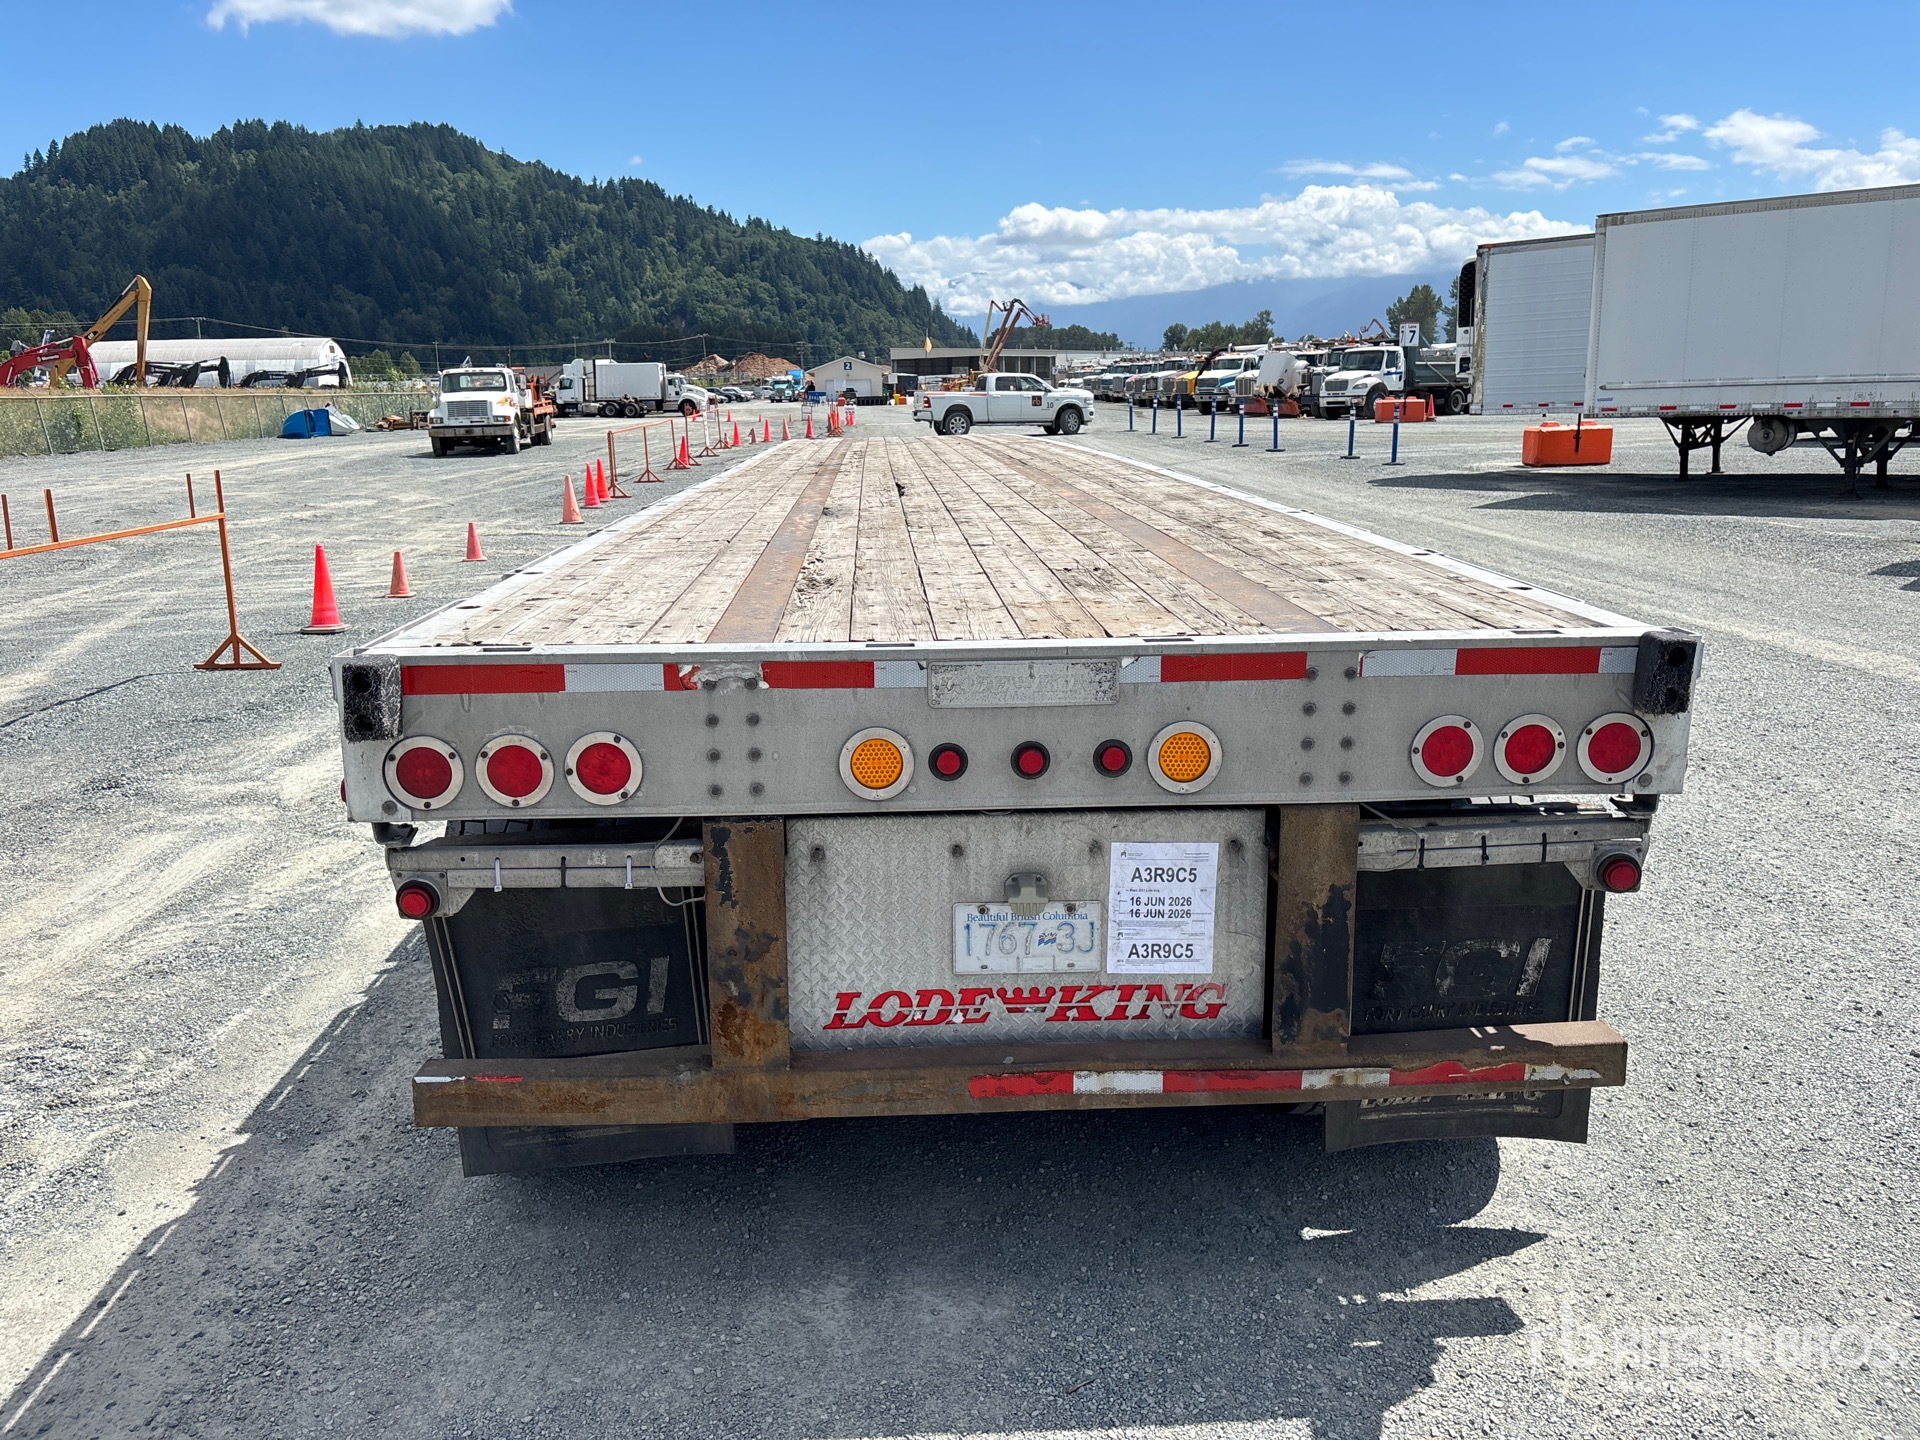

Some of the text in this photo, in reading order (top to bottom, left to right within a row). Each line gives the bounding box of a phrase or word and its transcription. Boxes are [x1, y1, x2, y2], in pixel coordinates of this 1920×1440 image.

[1409, 330, 1416, 343] 7
[1130, 866, 1197, 883] A3R9C5
[1129, 896, 1192, 907] 16 JUN 2026
[967, 912, 1008, 922] Beautiful
[1129, 908, 1192, 919] 16 JUN 2026
[964, 920, 1095, 956] 1767 3J
[1127, 943, 1194, 959] A3R9C5
[822, 983, 1228, 1030] LODE KING
